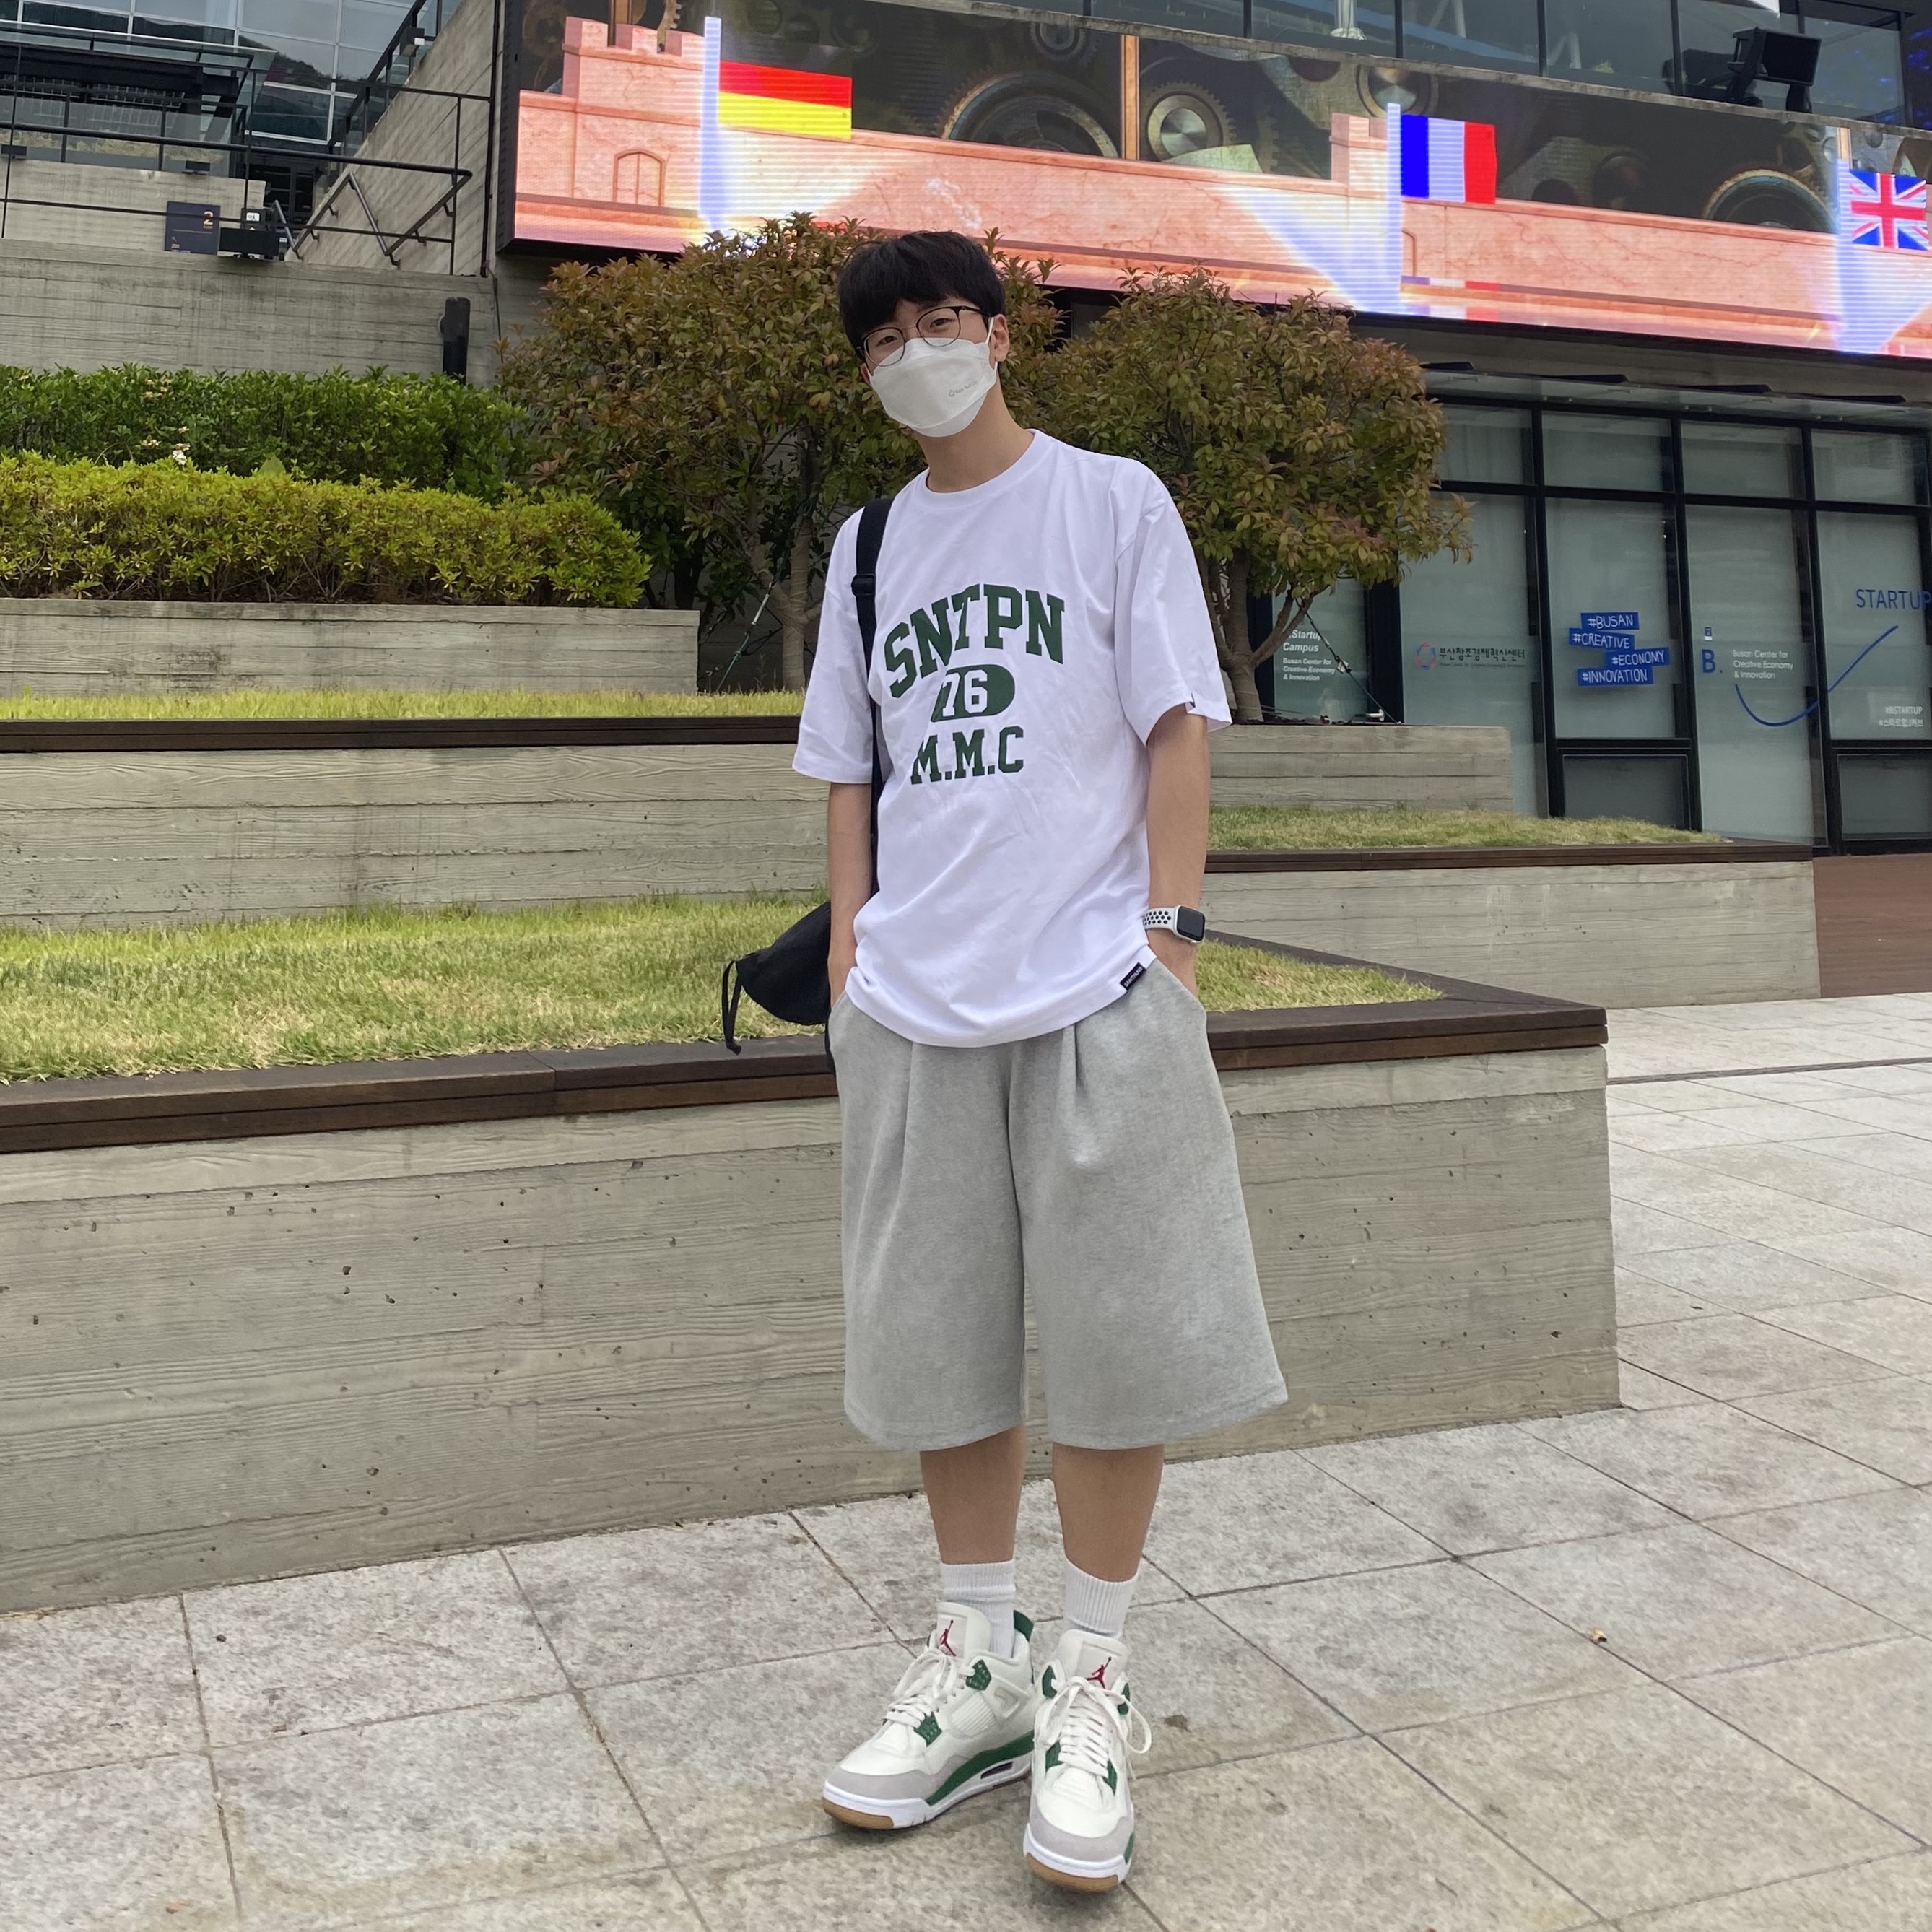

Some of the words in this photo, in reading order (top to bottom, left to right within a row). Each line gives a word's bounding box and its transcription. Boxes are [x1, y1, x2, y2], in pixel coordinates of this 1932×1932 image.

[1855, 589, 1932, 610] STARTUP
[1588, 614, 1633, 630] #BUSAN
[884, 583, 1065, 698] SNTPN
[1283, 642, 1319, 653] Campus
[1572, 633, 1630, 649] #CREATIVE
[1440, 648, 1526, 661] 부산창조경제혁신센터
[1611, 650, 1665, 666] #ECONOMY
[1733, 649, 1753, 658] Busan
[1754, 650, 1777, 658] Center
[1779, 650, 1788, 658] for
[1308, 666, 1336, 674] Economy
[1733, 660, 1762, 669] Creative
[1763, 660, 1793, 671] Economy
[1582, 668, 1648, 683] #INNOVATION
[1740, 671, 1776, 679] Innovation
[941, 669, 988, 717] 76
[910, 726, 1024, 785] M.M.C
